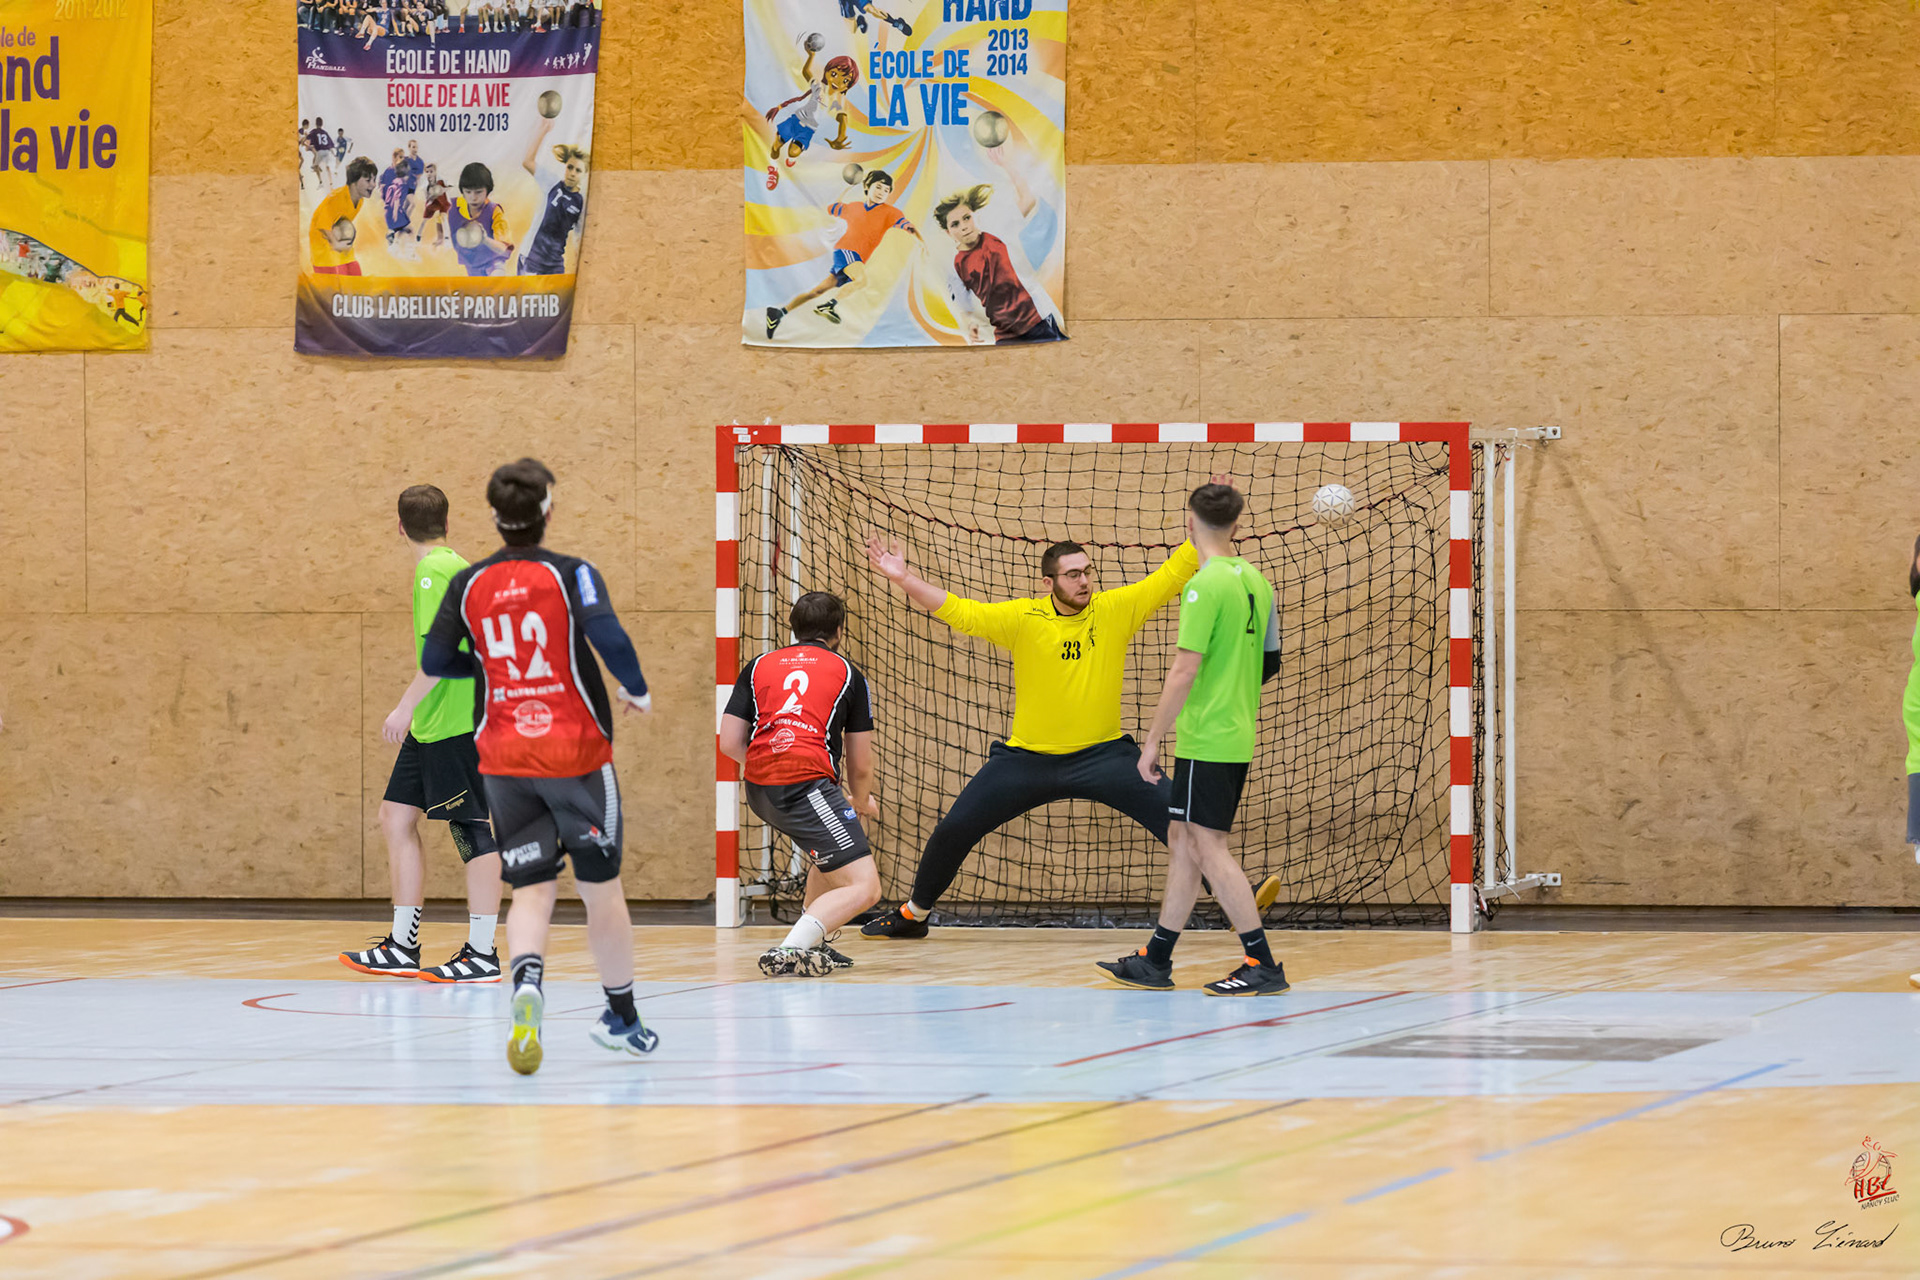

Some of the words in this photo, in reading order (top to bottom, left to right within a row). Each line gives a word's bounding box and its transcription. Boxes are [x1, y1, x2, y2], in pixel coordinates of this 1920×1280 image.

[17, 26, 36, 47] de
[988, 28, 1029, 51] 2013
[0, 36, 60, 103] nd
[386, 45, 436, 74] ÉCOLE
[439, 50, 460, 74] DE
[464, 49, 511, 74] HAND
[869, 42, 934, 79] ÉCOLE
[943, 50, 969, 78] DE
[986, 53, 1028, 76] 2014
[387, 78, 434, 108] ÉCOLE
[438, 84, 458, 108] DE
[462, 84, 480, 107] LA
[485, 83, 510, 107] VIE
[868, 84, 909, 127] LA
[920, 83, 969, 126] VIE
[388, 114, 435, 133] SAISON
[440, 113, 510, 132] 2012-2013
[0, 109, 38, 173] la
[50, 109, 118, 170] vie
[317, 133, 329, 145] 13
[332, 294, 374, 319] CLUB
[379, 292, 460, 319] LABELLISÉ
[464, 295, 495, 319] PAR
[499, 295, 518, 319] LA
[521, 295, 560, 318] FFHB
[481, 611, 553, 681] 42
[1061, 640, 1081, 660] 33
[775, 670, 809, 716] 2
